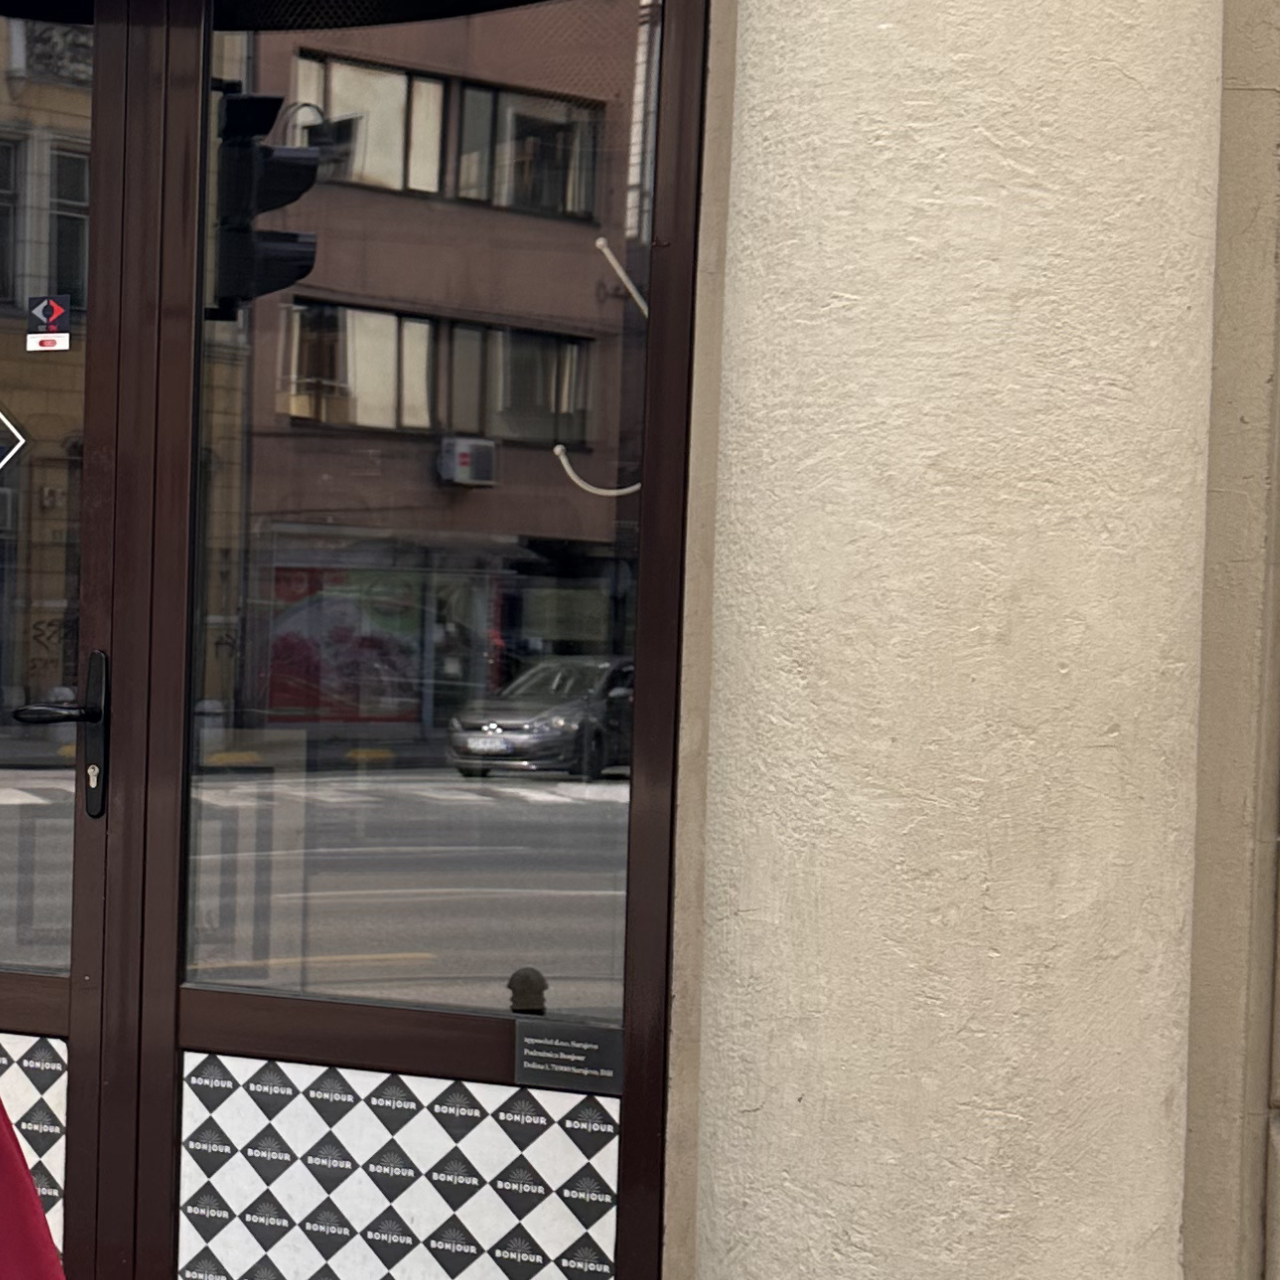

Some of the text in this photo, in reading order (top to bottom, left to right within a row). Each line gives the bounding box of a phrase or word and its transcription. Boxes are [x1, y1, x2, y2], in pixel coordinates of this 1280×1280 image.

[22, 1058, 63, 1071] BONJOUR
[190, 1076, 233, 1089] BONJOUR
[249, 1083, 293, 1095] BONJOUR
[309, 1090, 354, 1103] BONJOUR
[371, 1097, 416, 1110] BONJOUR
[434, 1104, 480, 1117] BONJOUR
[499, 1112, 547, 1125] BONJOUR
[21, 1121, 61, 1134] BONJOUR
[565, 1120, 614, 1133] BONJOUR
[188, 1141, 231, 1154] BONJOUR
[247, 1148, 291, 1161] BONJOUR
[307, 1156, 352, 1169] BONJOUR
[369, 1164, 414, 1177] BONJOUR
[432, 1172, 479, 1186] BONJOUR
[497, 1180, 545, 1194] BONJOUR
[563, 1189, 611, 1203] BONJOUR
[187, 1206, 229, 1219] BONJOUR
[245, 1214, 289, 1227] BONJOUR
[305, 1222, 350, 1236] BONJOUR
[367, 1231, 413, 1245] BONJOUR
[430, 1240, 477, 1254] BONJOUR
[495, 1249, 543, 1264] BONJOUR
[562, 1259, 610, 1273] BONJOUR
